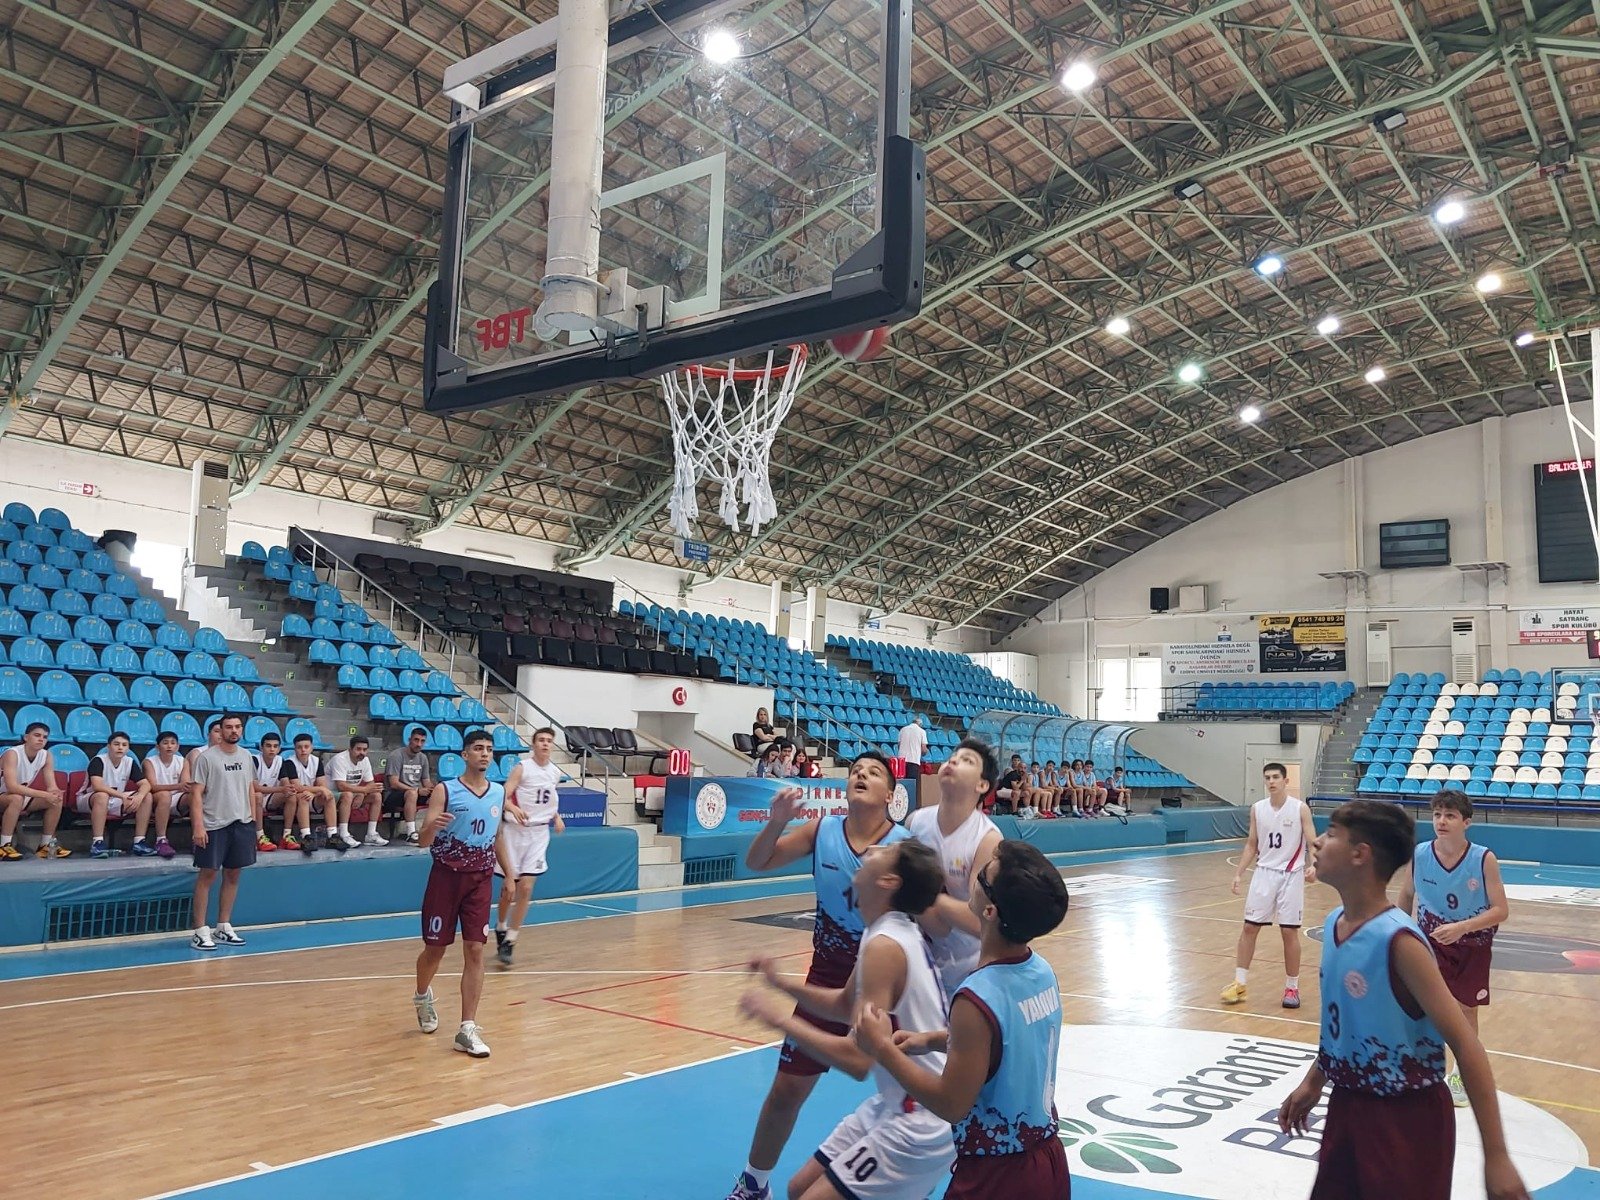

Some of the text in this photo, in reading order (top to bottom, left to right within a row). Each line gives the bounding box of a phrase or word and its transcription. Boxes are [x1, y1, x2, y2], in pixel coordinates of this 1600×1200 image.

[317, 699, 324, 707] E
[350, 727, 356, 735] D
[534, 789, 551, 804] 16
[470, 818, 486, 835] 10
[1268, 832, 1282, 848] 13
[1446, 893, 1459, 910] 9
[1327, 1001, 1340, 1040] 3
[1086, 1038, 1320, 1129] Garanti
[844, 1146, 878, 1183] 10
